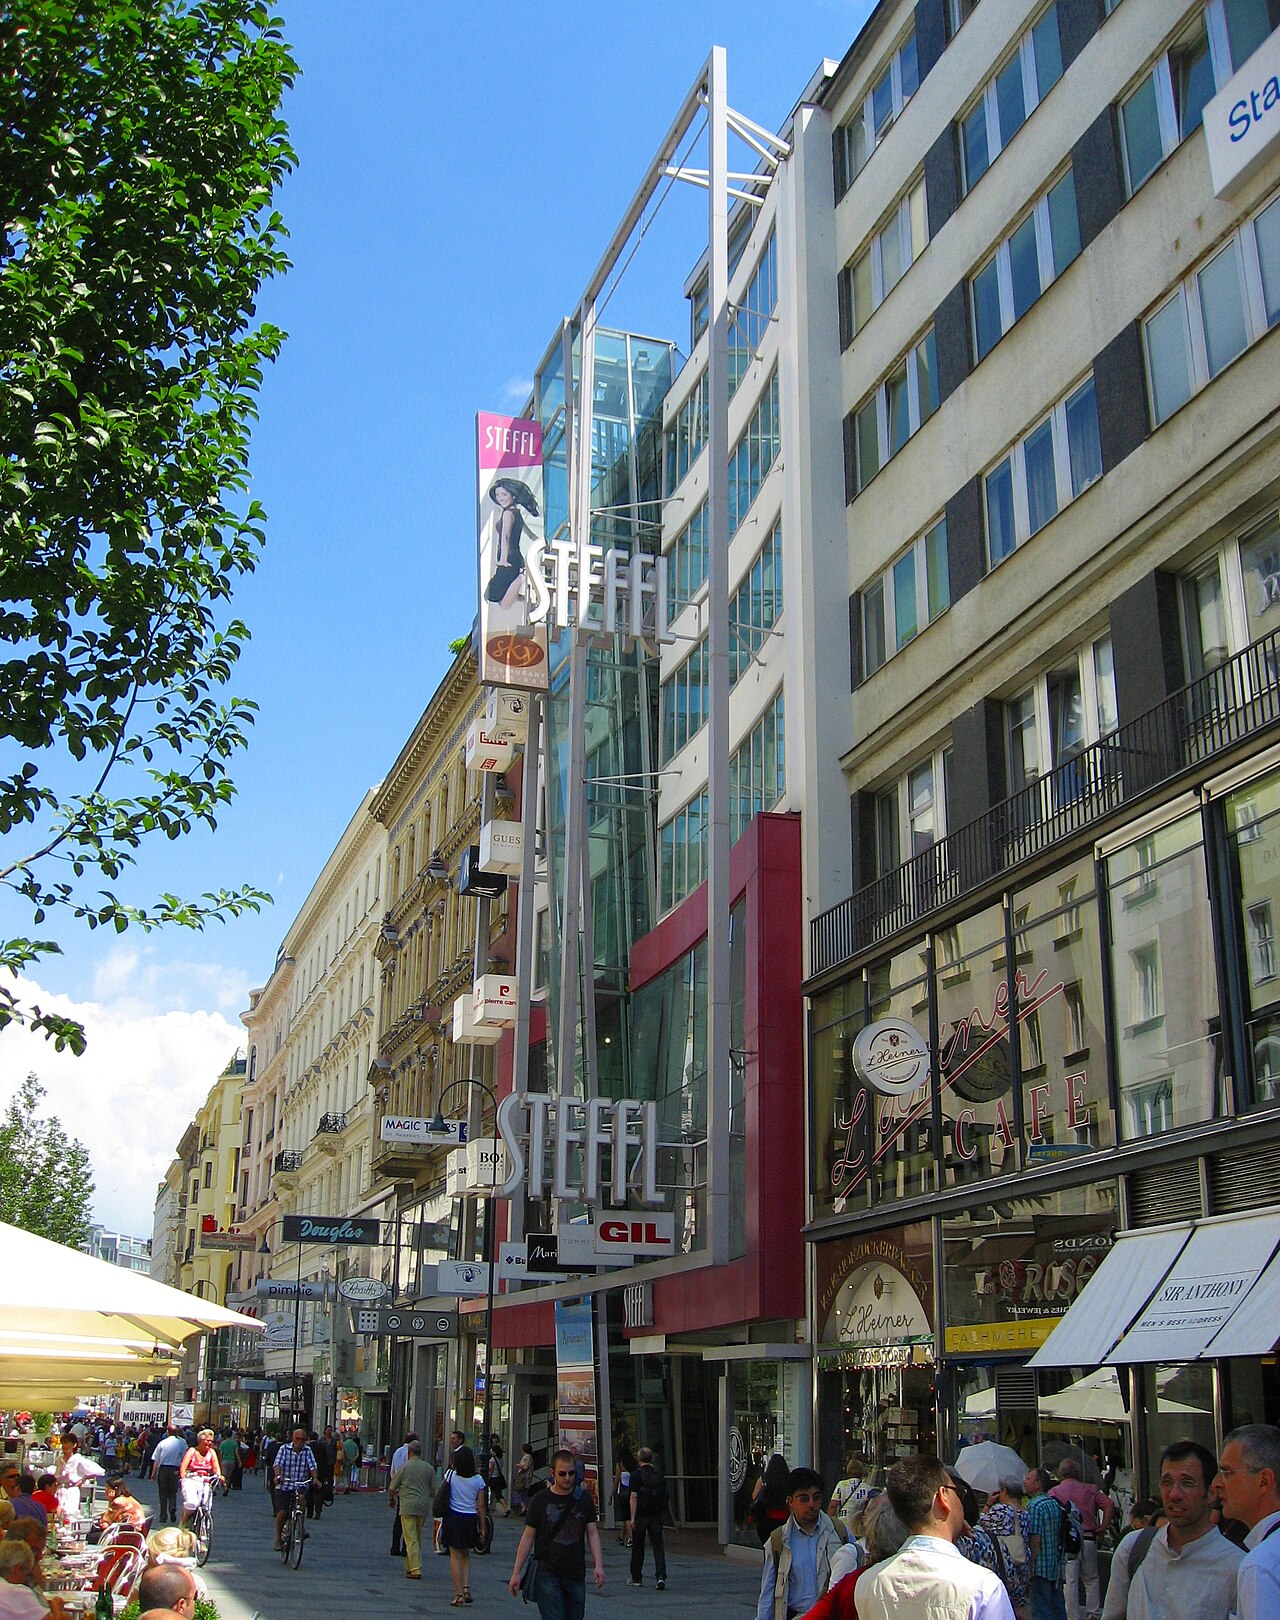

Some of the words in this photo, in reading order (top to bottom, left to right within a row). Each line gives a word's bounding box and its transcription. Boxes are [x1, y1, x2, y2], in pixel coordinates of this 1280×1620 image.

[485, 425, 536, 457] STEFFL
[525, 537, 676, 645] STEFFL
[876, 1048, 924, 1064] Heiner
[385, 1119, 421, 1131] MAGIC
[954, 1070, 1090, 1160] CAFE
[494, 1091, 666, 1202] STEFFL
[300, 1219, 364, 1242] Douglas
[599, 1221, 671, 1244] GIL
[268, 1283, 313, 1297] pimkie
[1159, 1286, 1185, 1301] SIR
[1181, 1279, 1249, 1300] ANTHONY
[856, 1303, 914, 1333] Heiner
[1166, 1318, 1187, 1326] BEST
[122, 1409, 165, 1422] MÖRTINGER
